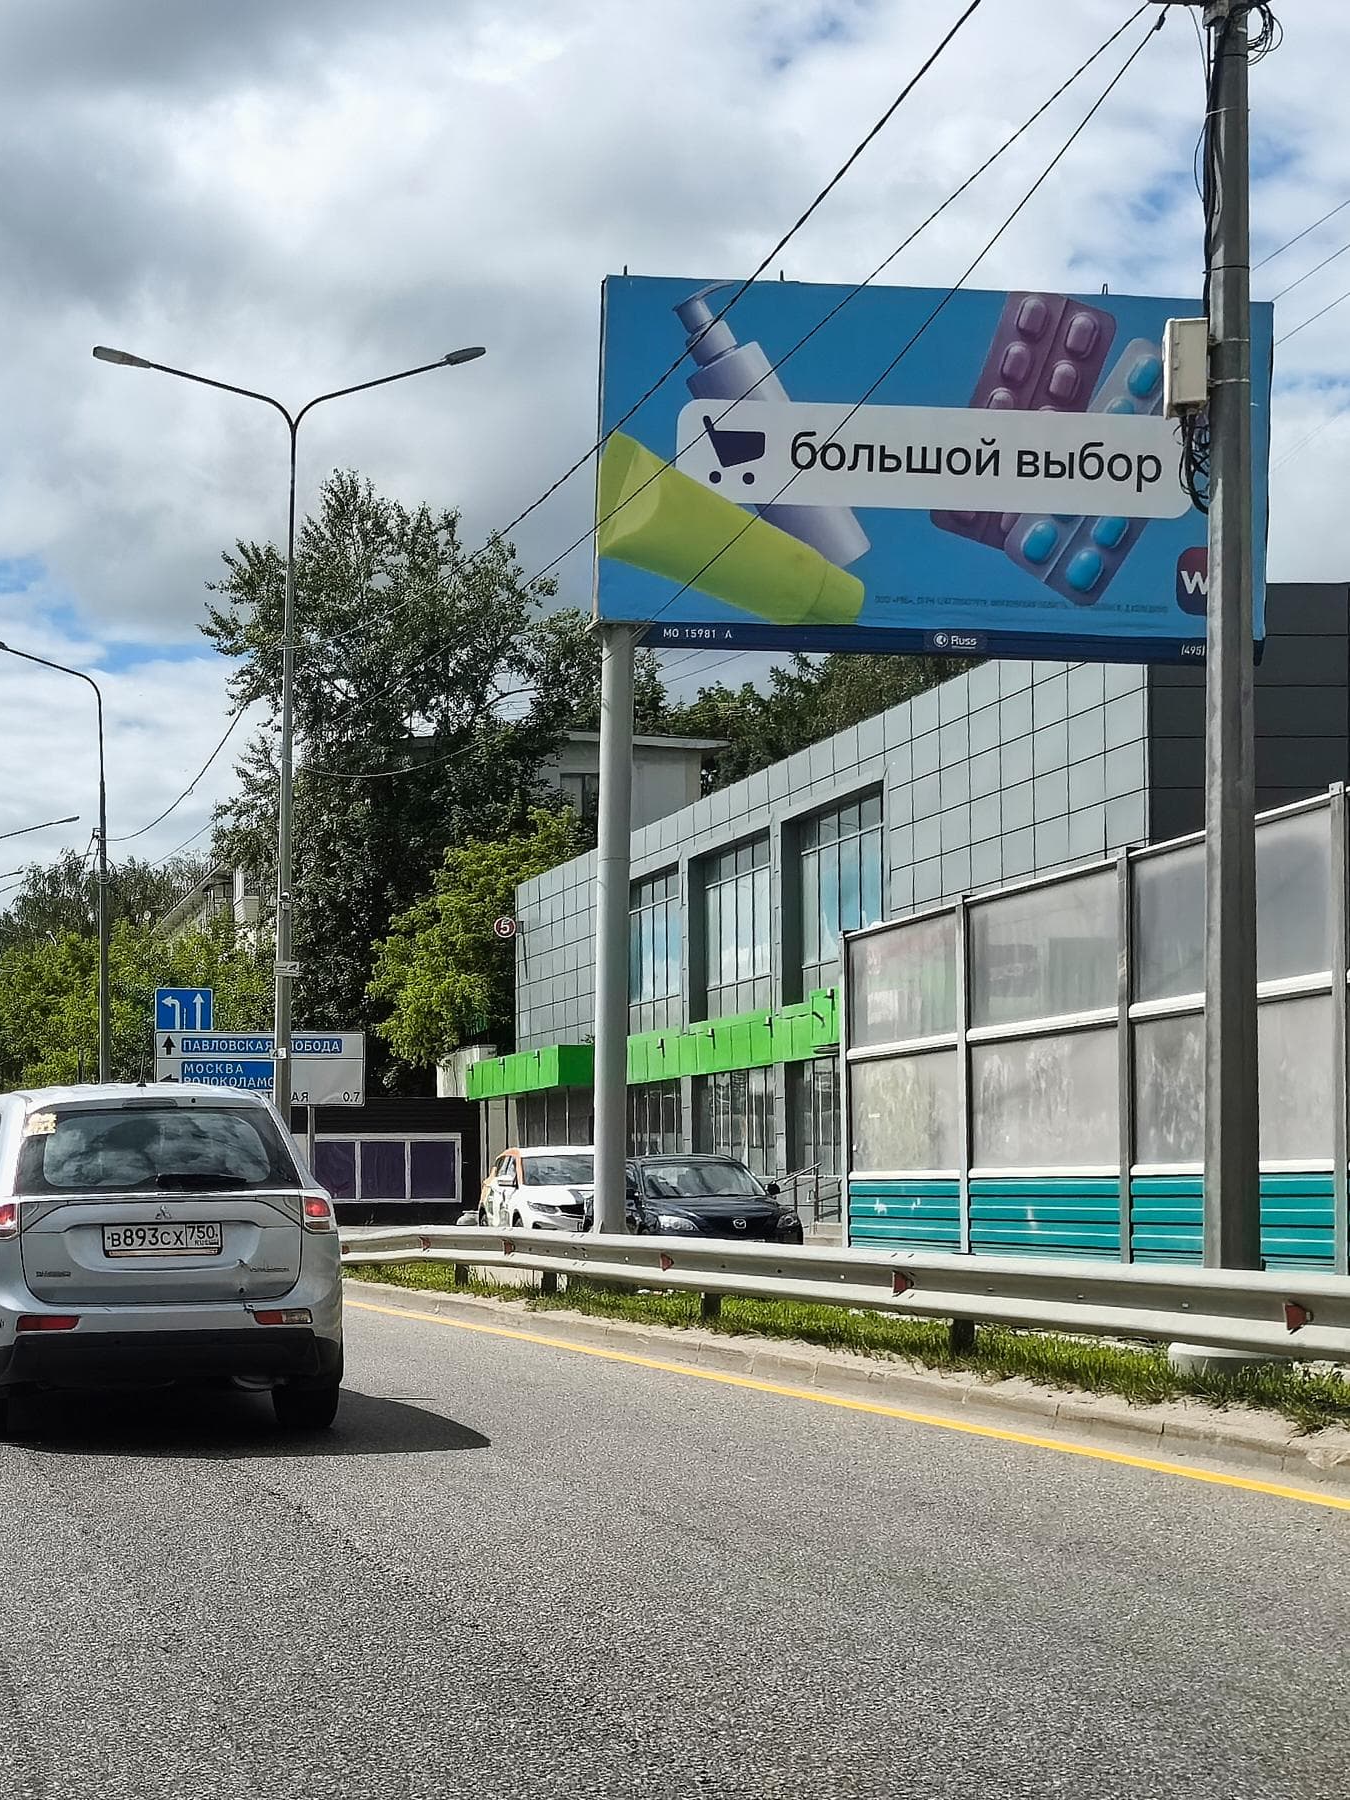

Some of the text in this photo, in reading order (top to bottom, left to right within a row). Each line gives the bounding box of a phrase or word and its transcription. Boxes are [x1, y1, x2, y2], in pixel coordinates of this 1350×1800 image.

[790, 430, 1162, 493] большой выбор
[685, 629, 716, 639] 15981
[951, 635, 977, 646] Russ
[500, 918, 511, 935] 5
[183, 1040, 274, 1052] ПАВЛОВСКАЯ
[184, 1063, 244, 1074] МОСКВА
[342, 1091, 361, 1102] 0.7
